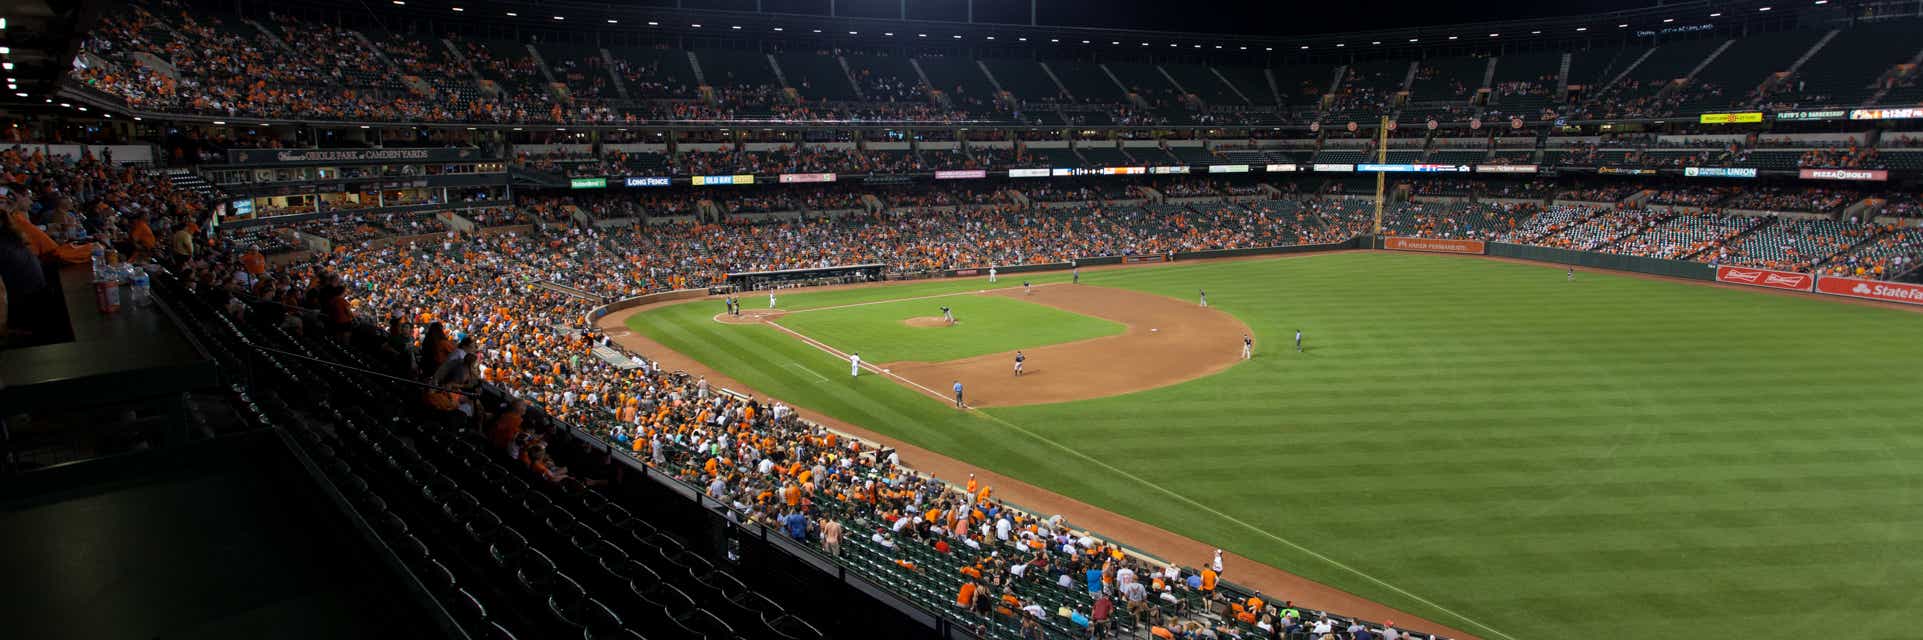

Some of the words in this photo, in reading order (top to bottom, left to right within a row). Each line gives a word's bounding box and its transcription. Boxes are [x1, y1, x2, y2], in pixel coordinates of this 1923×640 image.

[305, 151, 336, 160] ORIOLE
[336, 151, 358, 160] PARK
[365, 150, 401, 160] CAMDEN
[401, 150, 429, 159] YARDS
[1727, 168, 1757, 177] UNION
[627, 178, 647, 186] LONG
[647, 178, 669, 186] FENCE
[706, 175, 719, 185] OLD
[1872, 285, 1909, 297] State
